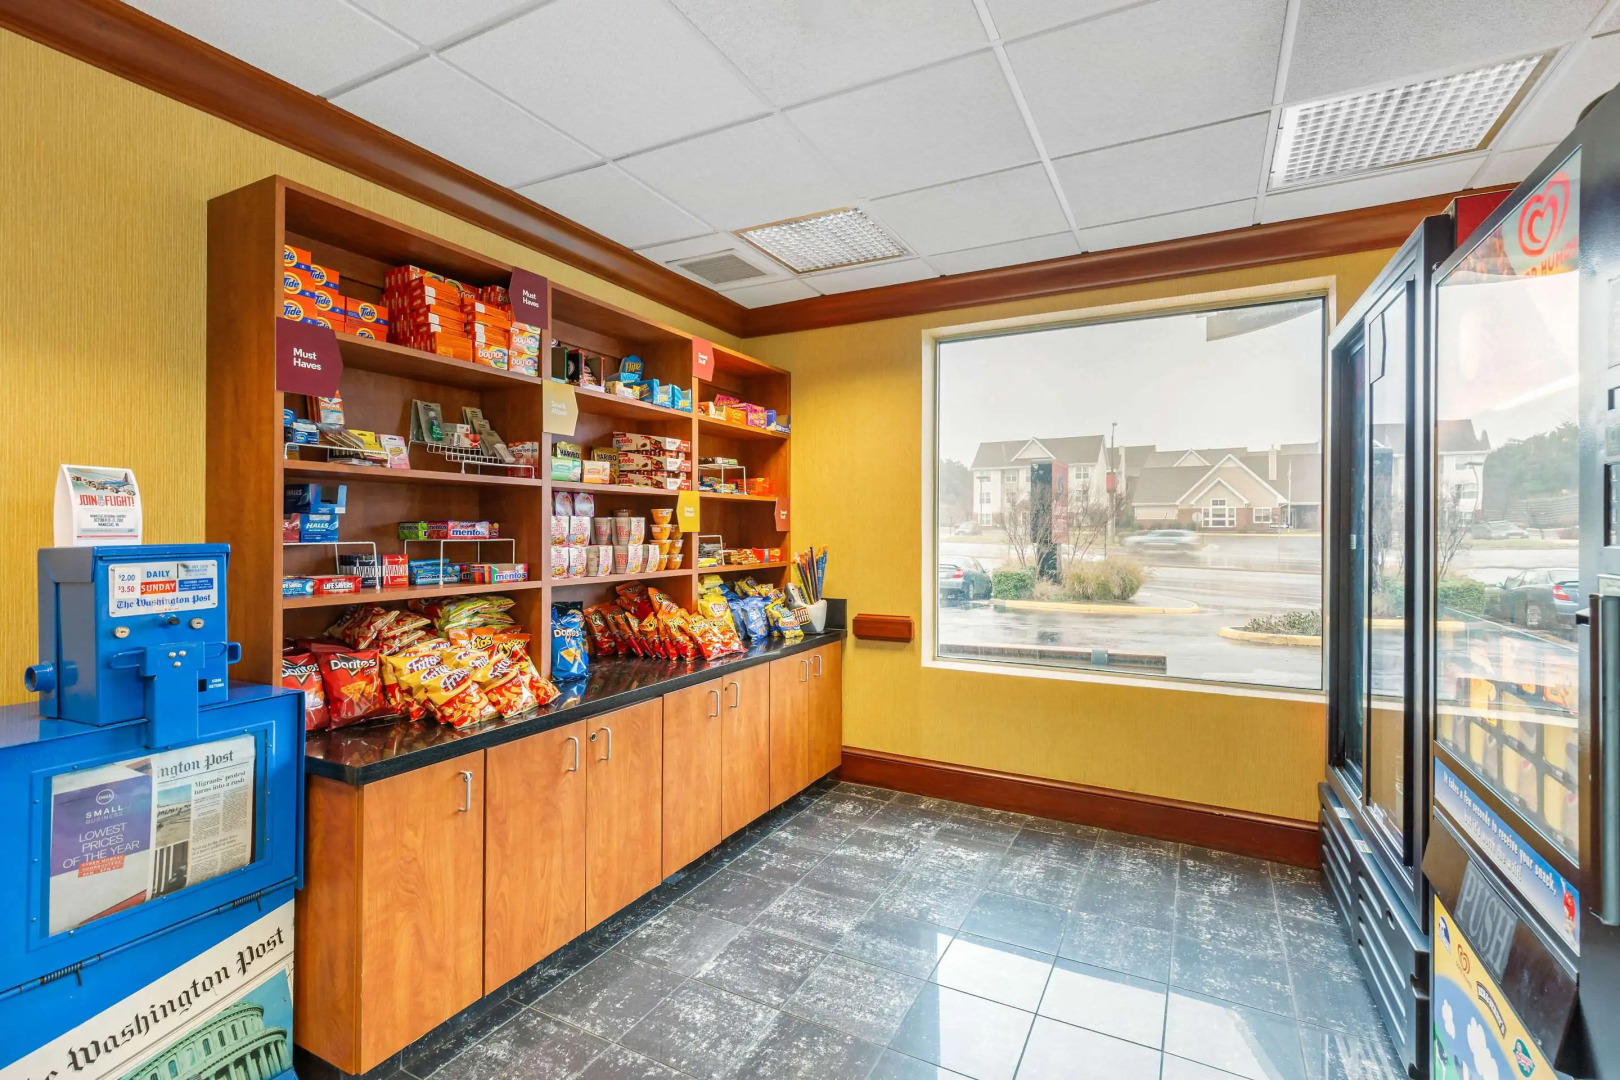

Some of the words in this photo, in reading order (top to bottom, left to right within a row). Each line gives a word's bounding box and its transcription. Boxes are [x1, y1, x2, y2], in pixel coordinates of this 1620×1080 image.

[310, 269, 325, 280] Tide
[522, 289, 537, 300] Must
[315, 295, 331, 306] Tide
[522, 296, 540, 309] Haves
[284, 305, 302, 316] Tide
[360, 306, 376, 317] Tide
[513, 334, 534, 345] bounce
[293, 347, 317, 360] Must
[478, 349, 504, 360] bounce
[293, 358, 322, 371] Haves
[511, 356, 534, 367] bounce
[560, 449, 580, 459] HARIBO
[597, 453, 617, 461] HARIBO
[79, 494, 97, 506] JOIN
[105, 495, 135, 507] FLIGHT!
[305, 522, 329, 530] HALLS
[451, 529, 486, 537] mentos
[118, 574, 136, 582] $2.00
[146, 570, 170, 578] DAILY
[495, 571, 527, 581] mentos
[118, 585, 135, 593] $3.50
[141, 582, 176, 593] SUNDAY
[335, 581, 354, 590] SAVERS
[116, 600, 133, 609] The
[136, 596, 190, 608] Washington
[192, 594, 211, 604] Post
[330, 659, 376, 671] Doritos
[204, 750, 234, 770] Post
[195, 776, 224, 788] Migrants'
[225, 770, 246, 782] protest
[194, 787, 212, 795] turns
[231, 778, 245, 786] rush
[85, 805, 123, 819] SMALL
[85, 811, 124, 825] BUSINESS
[79, 822, 127, 842] LOWEST
[1448, 777, 1459, 795] takes
[1464, 790, 1472, 807] few
[1473, 803, 1490, 828] seconds
[1492, 819, 1498, 834] to
[1499, 828, 1518, 855] receive
[1519, 849, 1533, 870] your
[1535, 864, 1557, 896] snack,
[82, 834, 124, 852] PRICES
[62, 856, 81, 869] OF
[83, 848, 107, 862] THE
[110, 840, 140, 855] YEAR
[1458, 867, 1514, 975] PUSH
[67, 964, 230, 1072] Washington
[236, 927, 285, 977] Post
